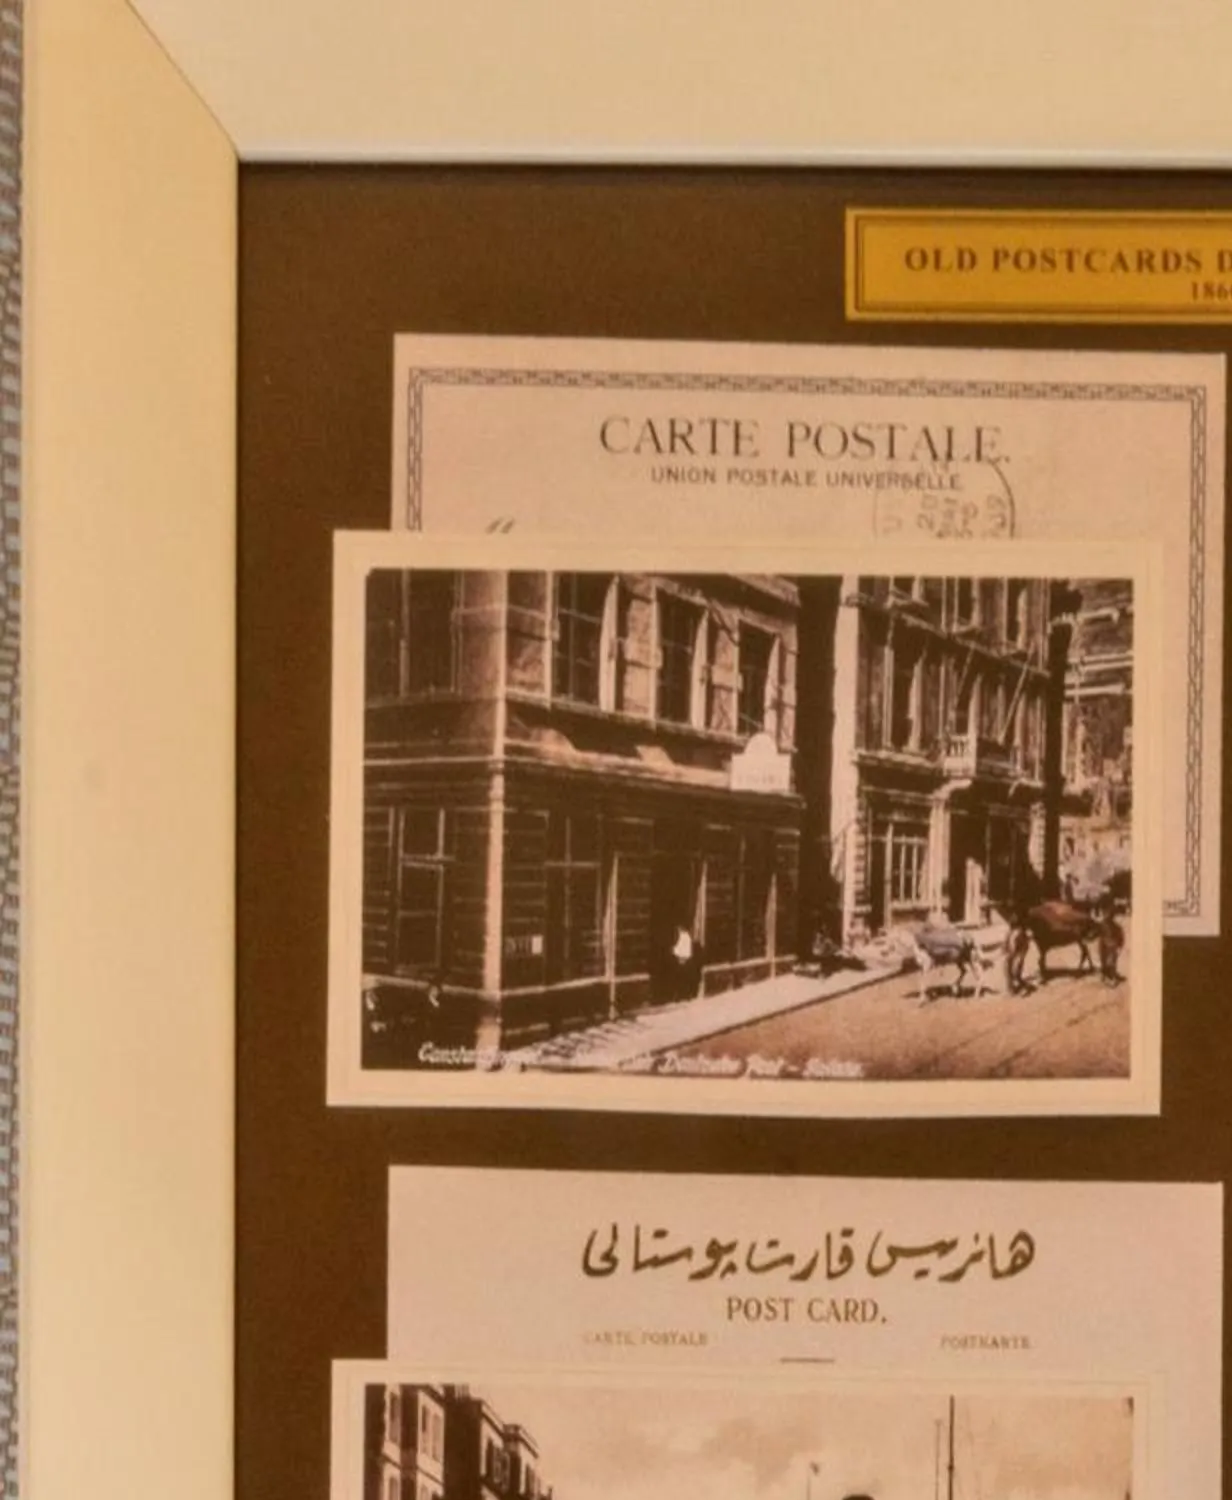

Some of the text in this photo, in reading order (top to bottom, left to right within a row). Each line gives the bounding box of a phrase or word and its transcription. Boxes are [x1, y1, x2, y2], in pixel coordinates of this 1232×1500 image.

[904, 246, 978, 273] OLD
[992, 246, 1203, 274] POSTCARDS
[600, 415, 760, 458] CARTE
[651, 467, 963, 491] UNION POSTALE UNIVERSELLE
[726, 1296, 888, 1323] POST CARD.
